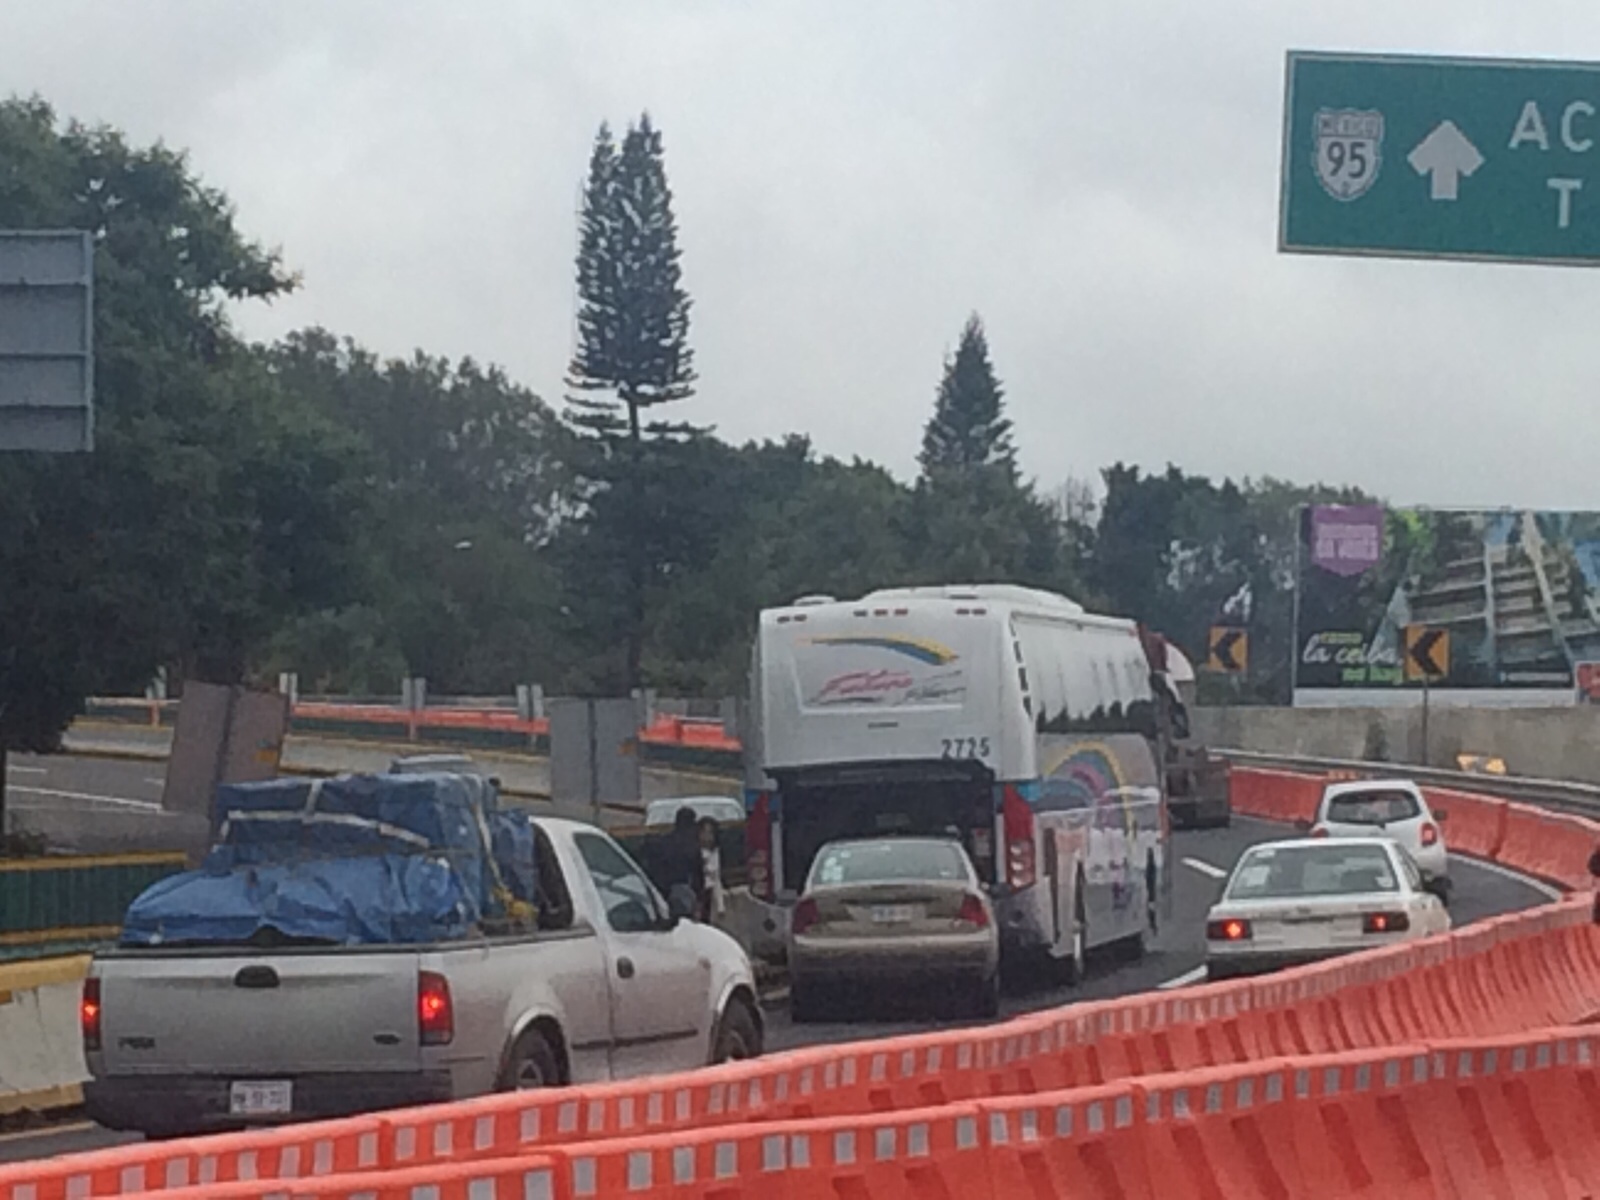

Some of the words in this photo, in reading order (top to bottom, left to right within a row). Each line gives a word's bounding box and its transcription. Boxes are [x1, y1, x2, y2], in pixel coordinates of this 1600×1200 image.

[1508, 101, 1595, 152] AC
[1327, 141, 1367, 178] 95
[1547, 179, 1582, 228] T
[941, 737, 990, 758] 2725
